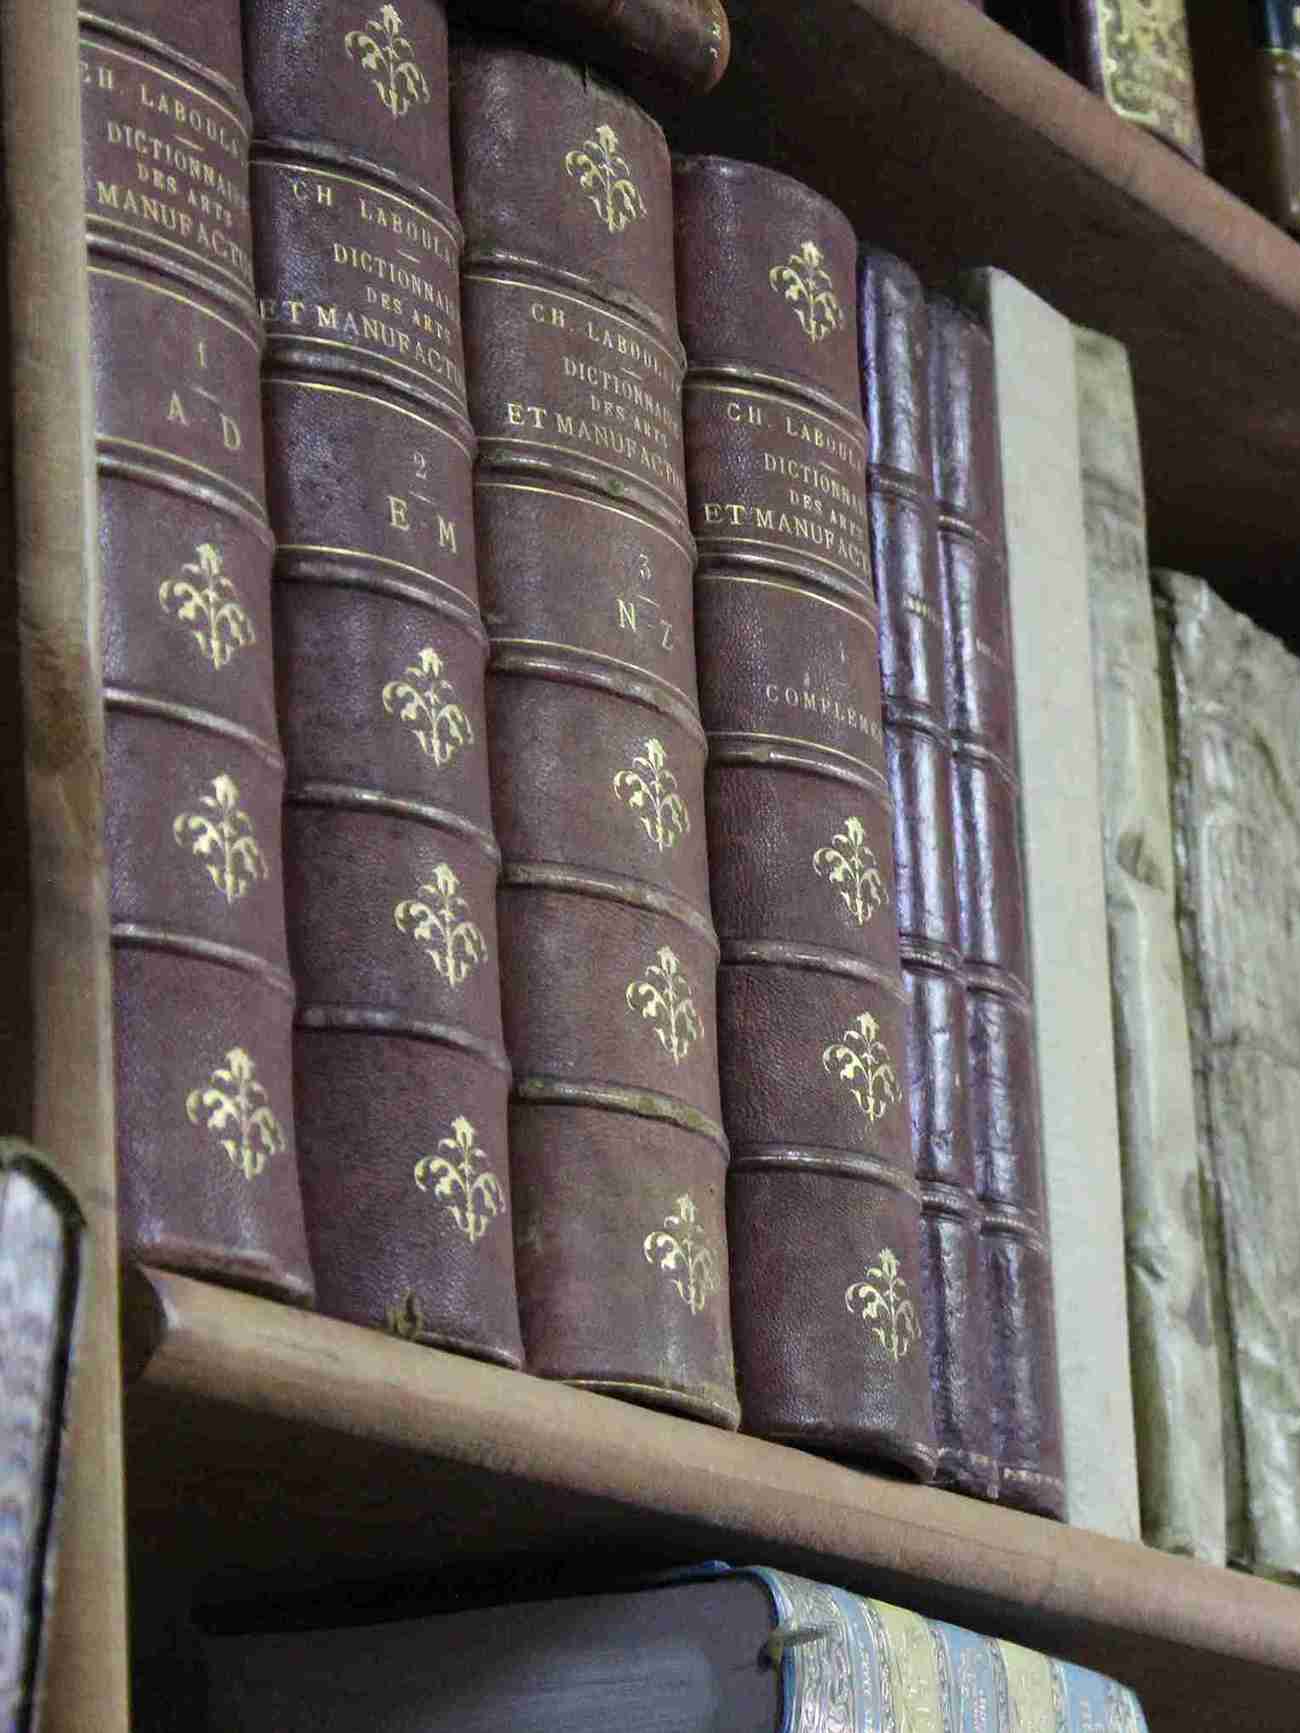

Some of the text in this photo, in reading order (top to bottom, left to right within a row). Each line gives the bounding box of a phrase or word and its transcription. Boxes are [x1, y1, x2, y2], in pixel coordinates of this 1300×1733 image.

[107, 120, 247, 212] DICTIONNAI
[136, 162, 177, 194] DES
[366, 286, 402, 315] DES
[563, 356, 678, 438] DICTIONNAI
[590, 394, 625, 421] DES
[167, 389, 243, 451] A D
[504, 402, 547, 429] ET
[413, 450, 428, 480] 2
[703, 503, 746, 527] ET
[789, 489, 823, 513] DES
[436, 513, 458, 554] M
